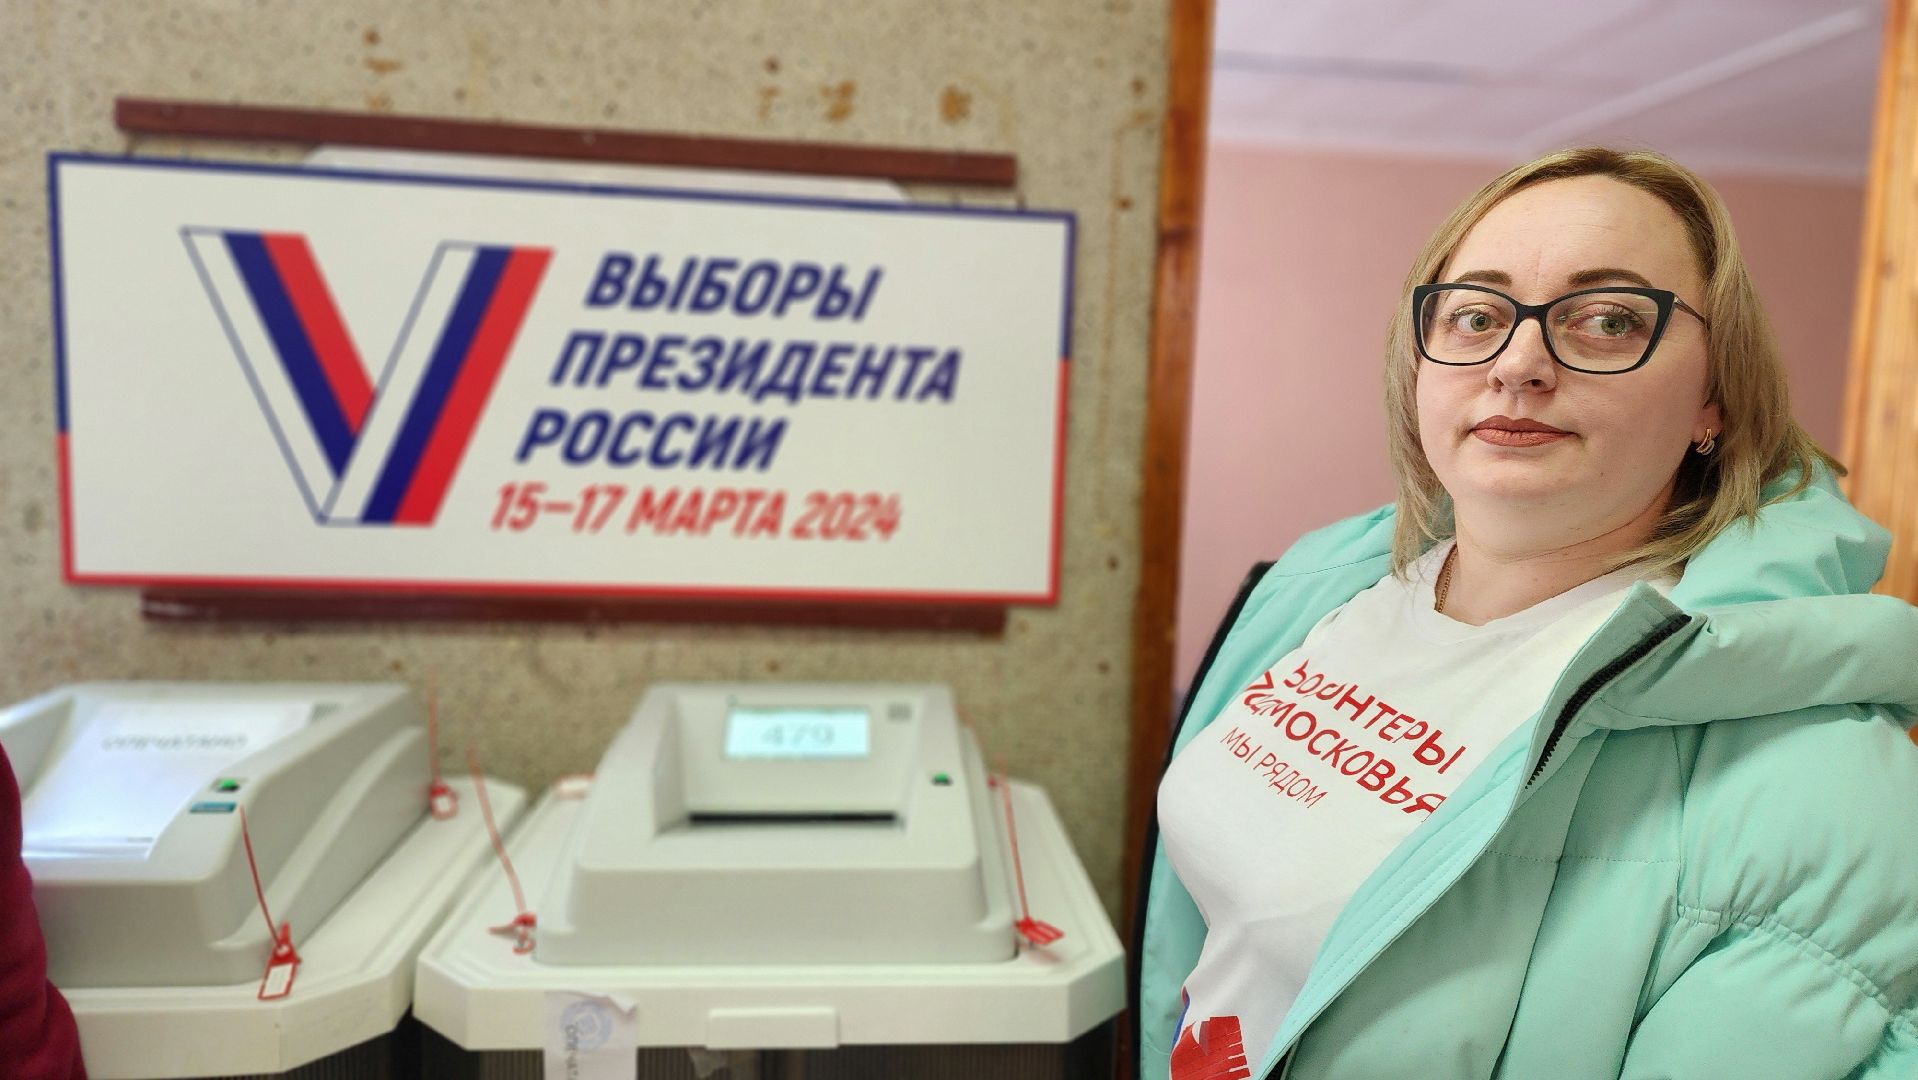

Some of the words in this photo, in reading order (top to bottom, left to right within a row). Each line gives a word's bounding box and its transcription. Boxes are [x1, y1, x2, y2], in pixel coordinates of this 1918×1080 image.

[584, 252, 883, 322] ВЫБОРЫ
[549, 330, 962, 405] ПРЕЗИДЕНТА
[515, 407, 788, 472] РОССИИ
[624, 486, 787, 538] МАРТА
[789, 490, 901, 541] 2024
[760, 722, 836, 746] 479
[1283, 658, 1467, 775] ООНТЕРЫ
[1220, 726, 1262, 764] МЫ
[1252, 751, 1328, 809] РЯДОМ
